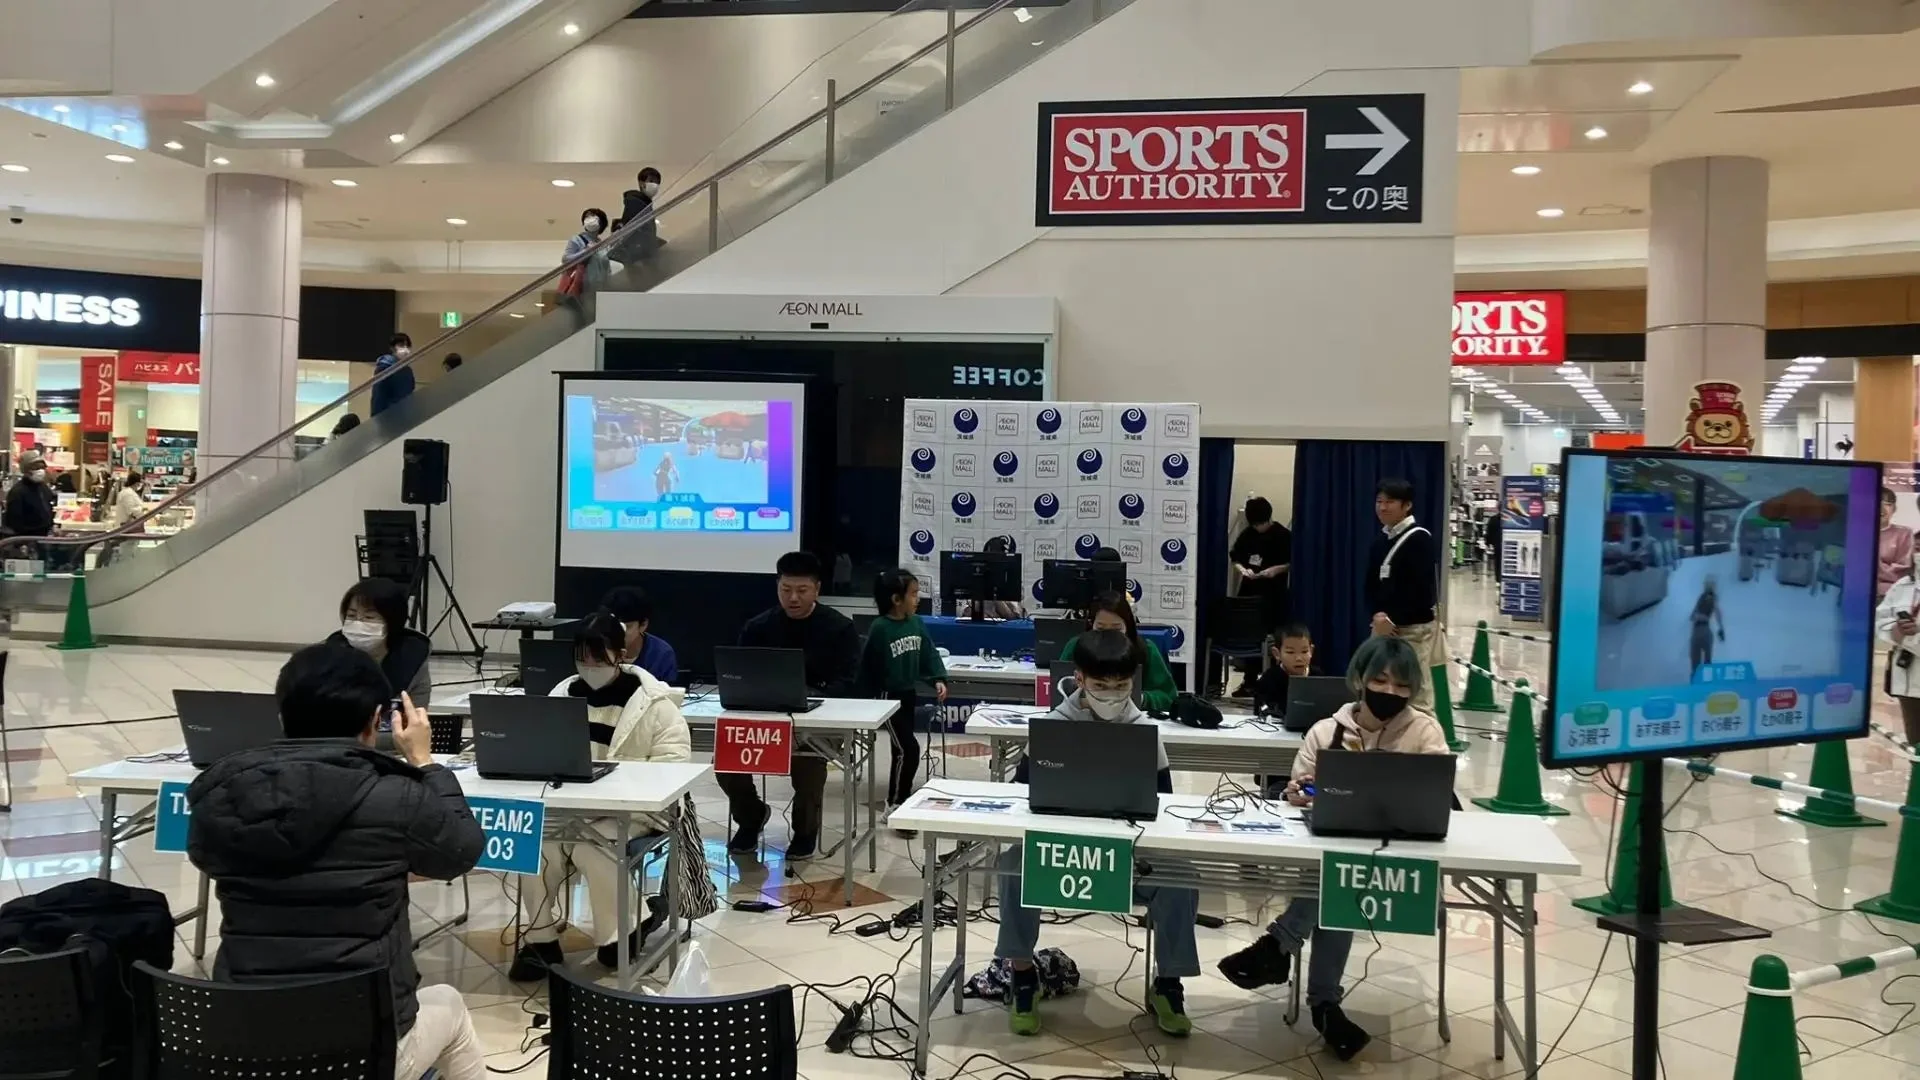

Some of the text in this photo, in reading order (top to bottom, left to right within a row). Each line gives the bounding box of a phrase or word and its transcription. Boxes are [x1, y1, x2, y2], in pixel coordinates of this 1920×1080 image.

[1063, 124, 1290, 174] SPORTS
[1063, 172, 1287, 201] AUTHORITY
[1325, 185, 1409, 212] この奥
[822, 302, 863, 316] MALL
[1452, 335, 1547, 357] ORITY
[96, 362, 113, 426] SALE
[724, 726, 782, 745] TEAM4
[740, 748, 763, 766] 07
[469, 807, 533, 835] TEAM2
[487, 836, 514, 861] 03
[1036, 841, 1116, 872] TEAM1
[1059, 873, 1093, 900] 02
[1335, 862, 1421, 895] TEAM1
[1360, 896, 1393, 921] 01
